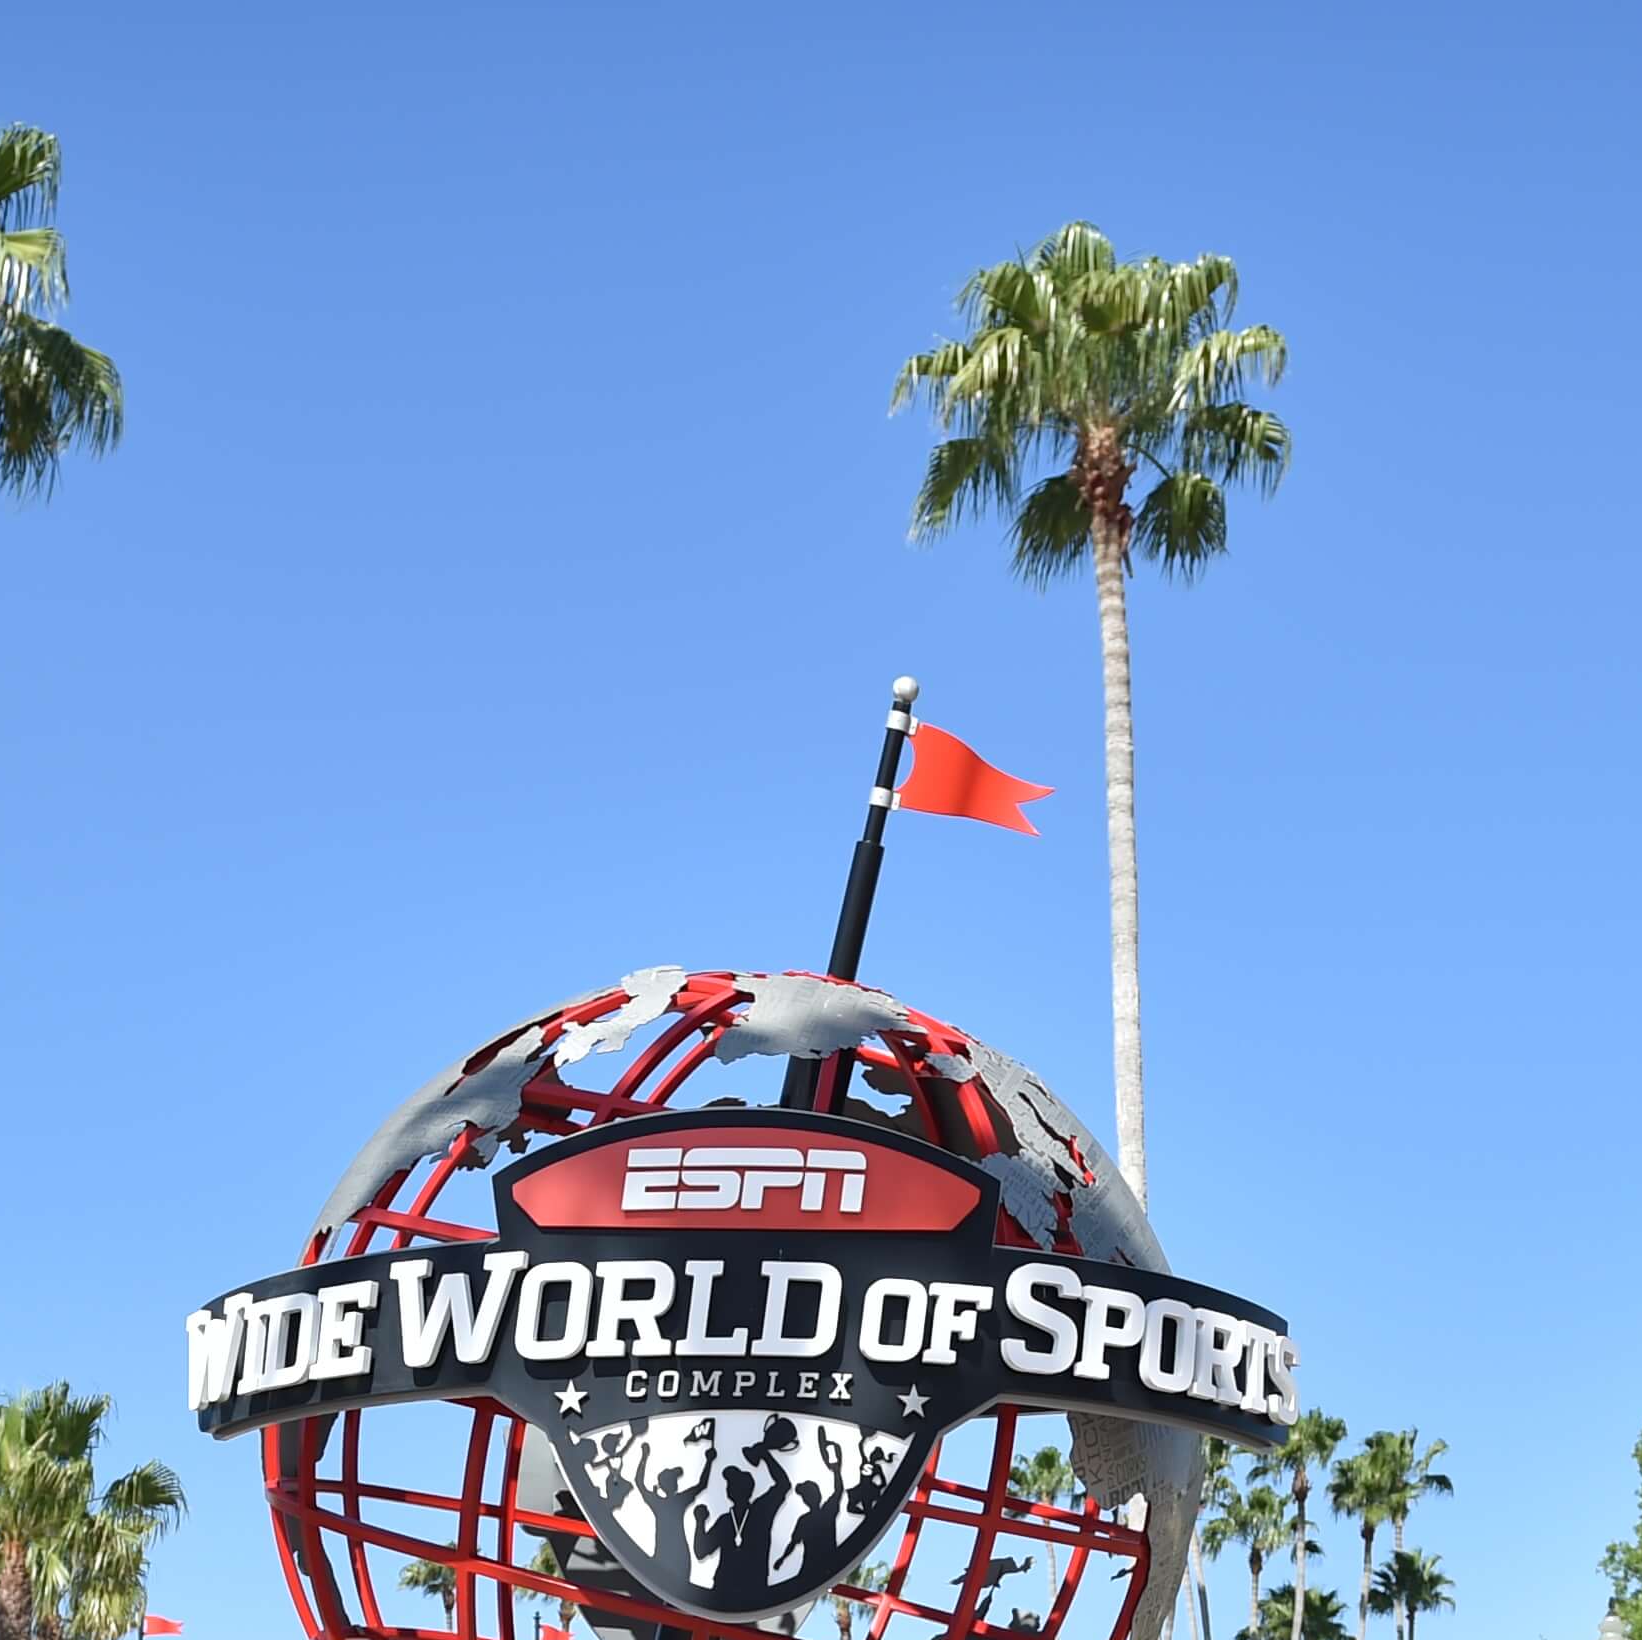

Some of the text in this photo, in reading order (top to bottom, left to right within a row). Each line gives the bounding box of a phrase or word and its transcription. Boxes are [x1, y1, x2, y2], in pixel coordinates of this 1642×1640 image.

[621, 1147, 867, 1213] ESPN
[186, 1250, 1300, 1426] WIDE WORLD OF SPORTS
[625, 1369, 854, 1400] COMPLEX
